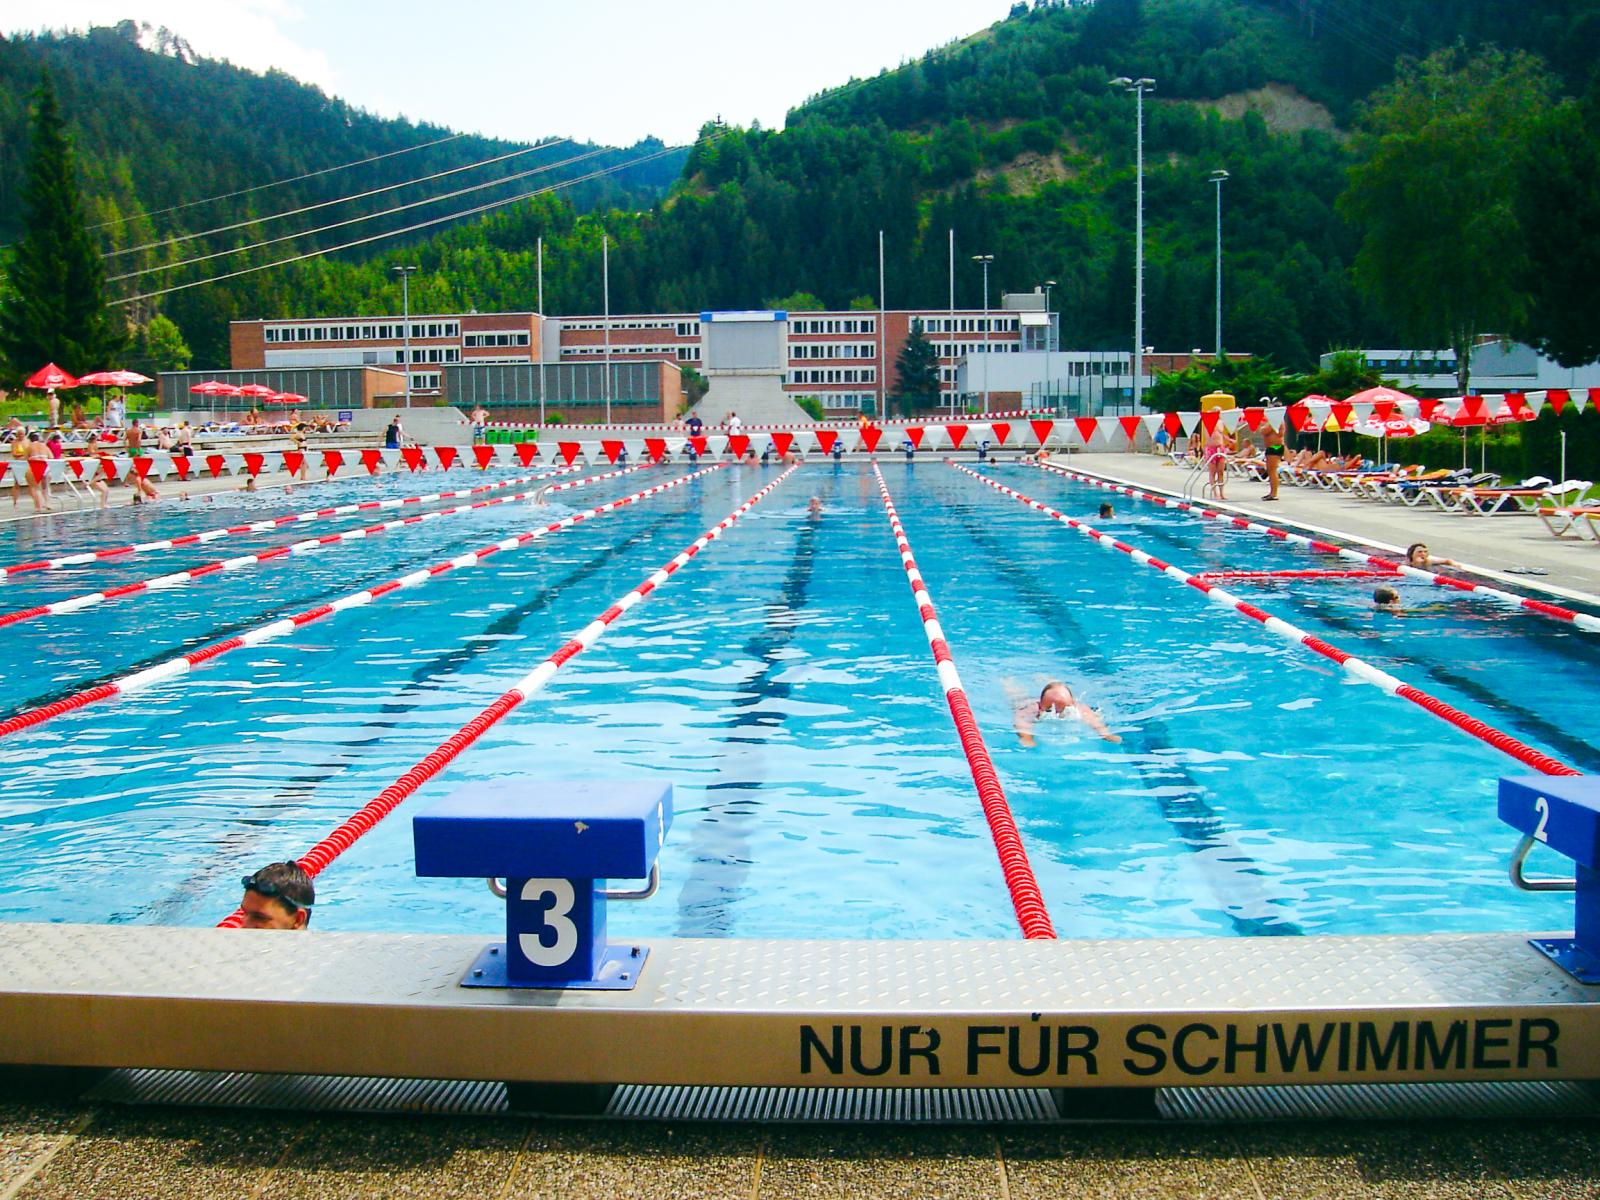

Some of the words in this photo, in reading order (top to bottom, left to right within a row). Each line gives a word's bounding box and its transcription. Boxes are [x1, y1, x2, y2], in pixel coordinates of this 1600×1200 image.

[1534, 797, 1549, 843] 2
[519, 878, 578, 967] 3
[800, 1025, 941, 1076] NUR
[1123, 1017, 1560, 1076] SCHWIMMER
